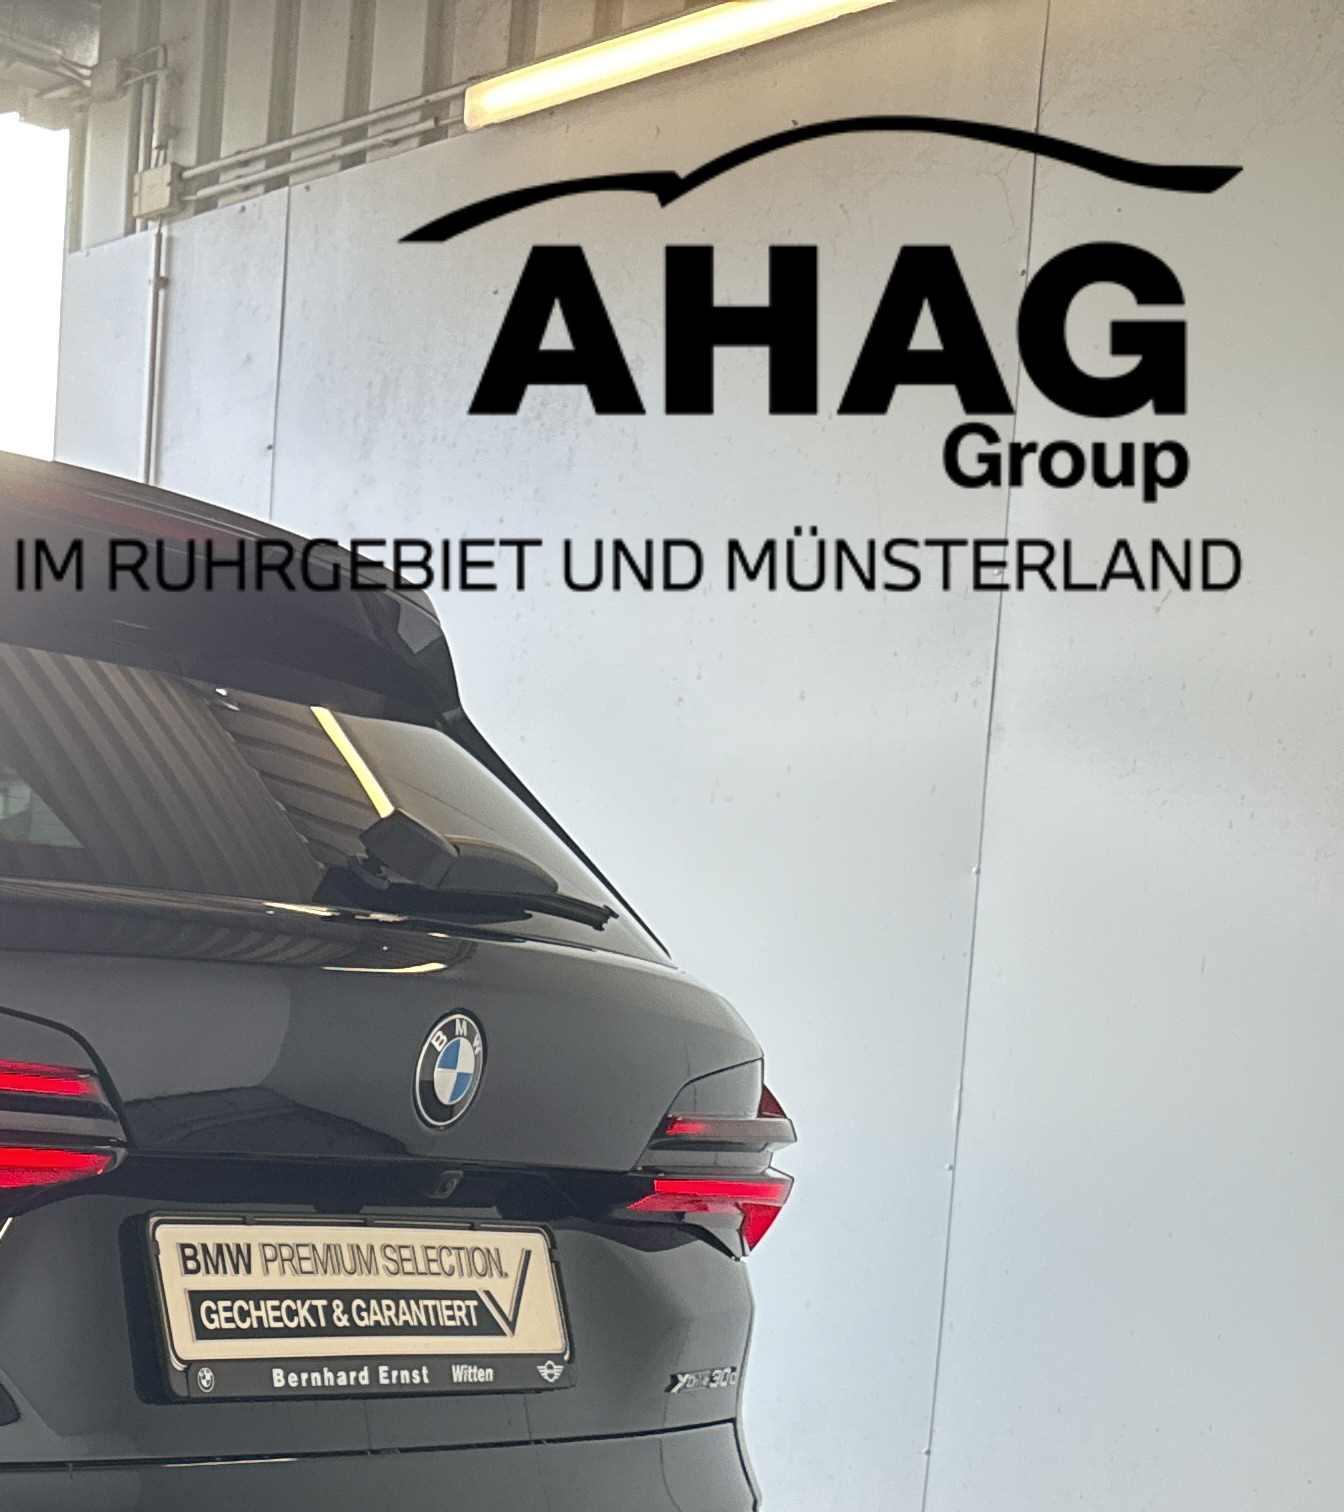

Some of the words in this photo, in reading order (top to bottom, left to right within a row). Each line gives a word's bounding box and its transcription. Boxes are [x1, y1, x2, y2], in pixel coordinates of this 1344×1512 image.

[430, 1018, 482, 1056] BMW
[178, 1242, 252, 1276] BMW
[259, 1242, 380, 1276] PREMIUM
[199, 1298, 328, 1330] GECHECKT
[331, 1298, 350, 1328] &
[351, 1298, 479, 1328] GARANTIERT
[271, 1366, 369, 1388] Bernhard
[378, 1365, 430, 1385] Ernst
[451, 1364, 494, 1383] Witten
